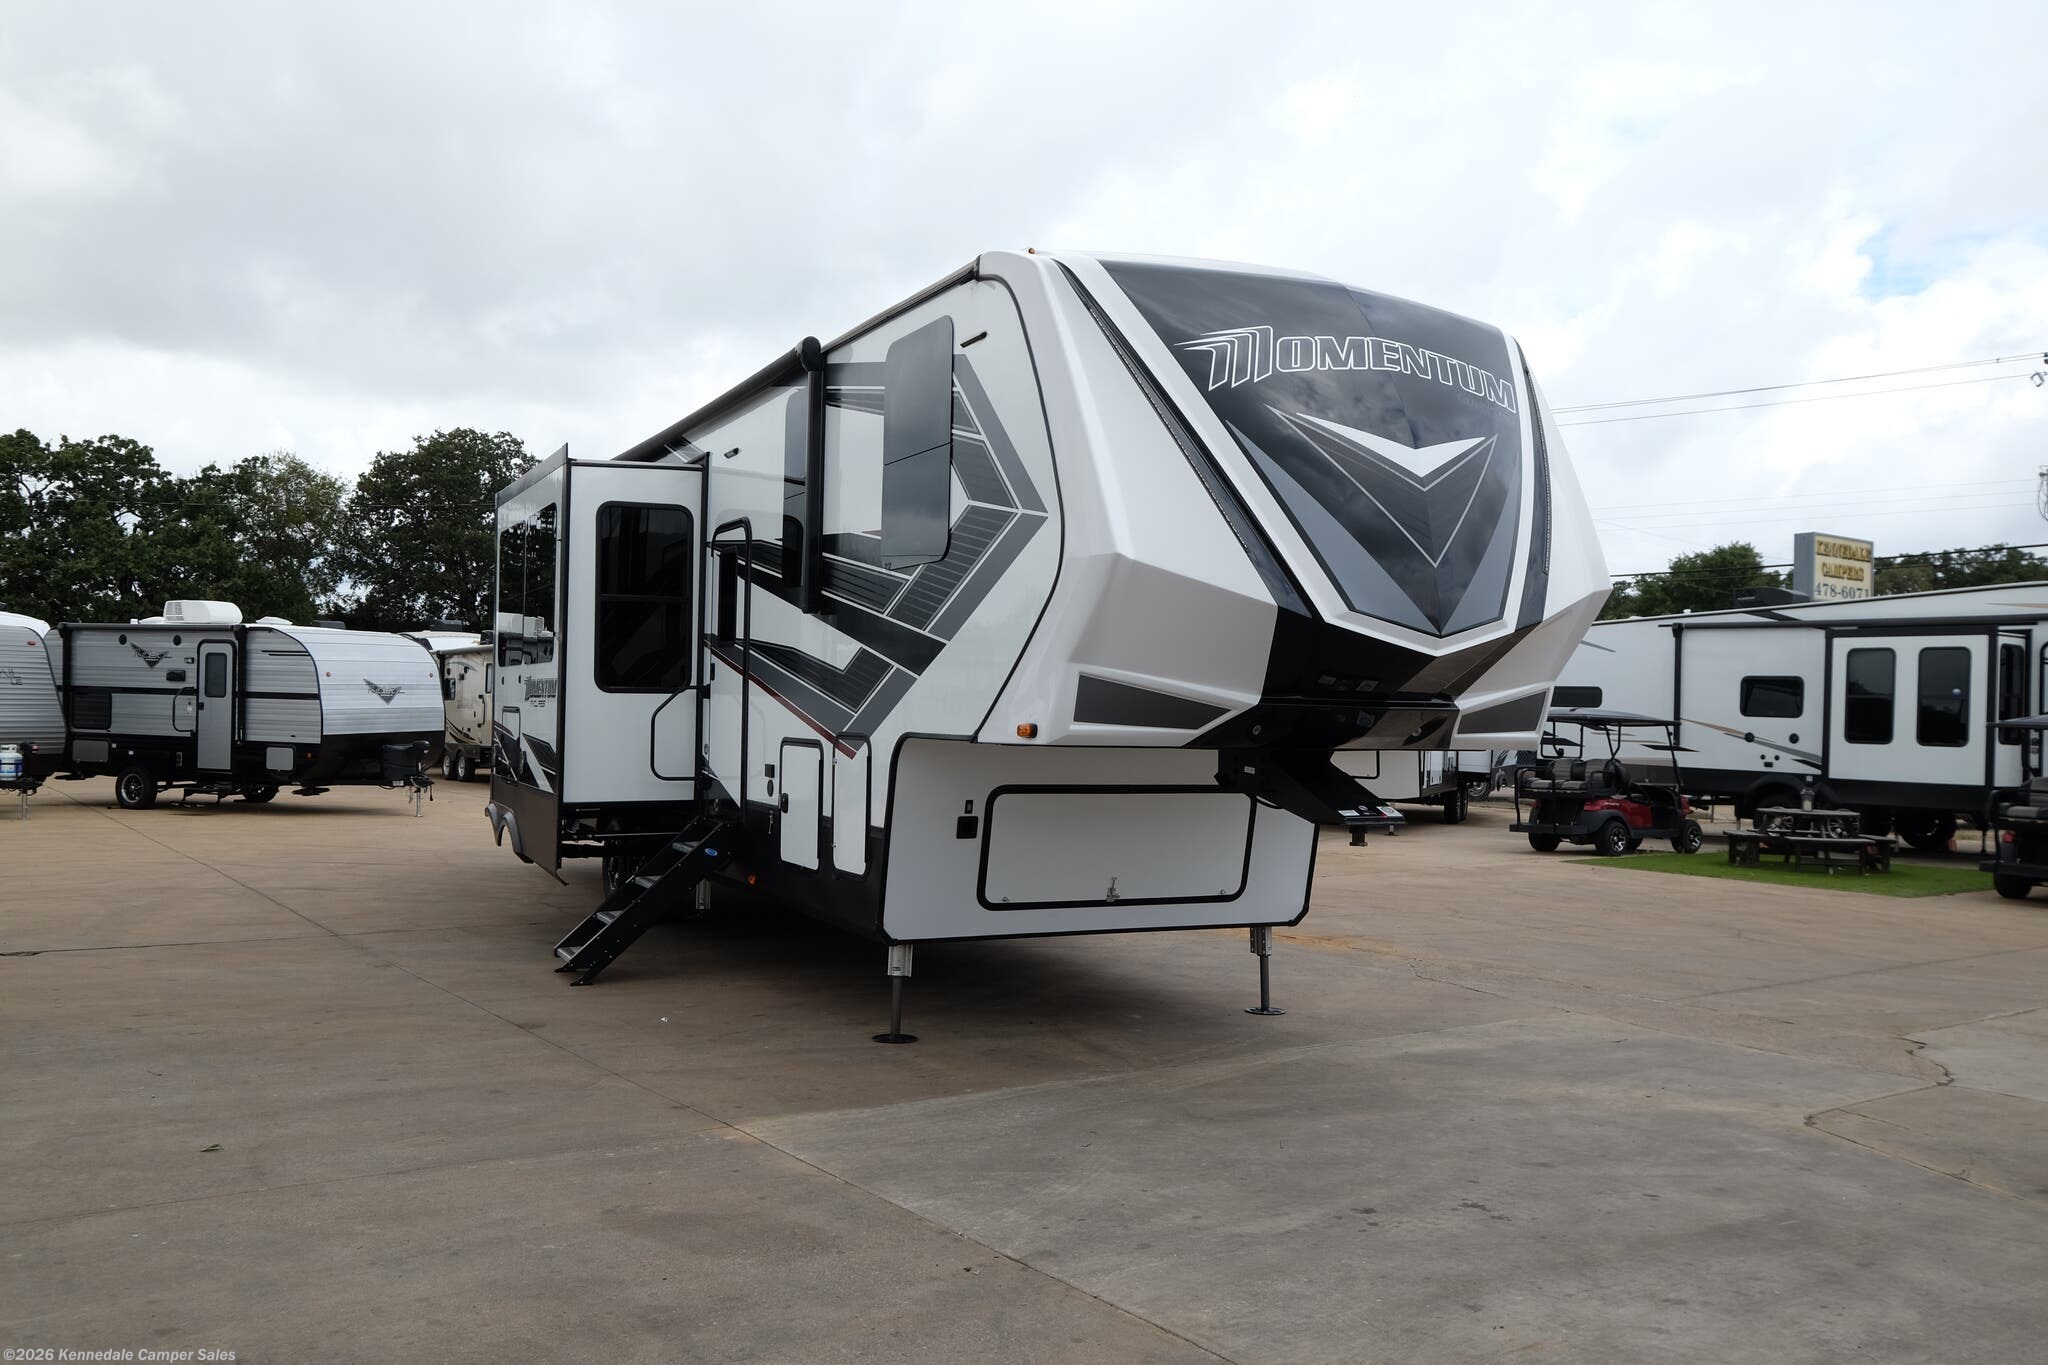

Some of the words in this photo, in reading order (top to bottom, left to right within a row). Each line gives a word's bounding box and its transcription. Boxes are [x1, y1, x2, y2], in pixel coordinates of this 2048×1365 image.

[1173, 325, 1517, 414] MOMENTUM
[1821, 561, 1864, 582] CAMPERS
[1814, 581, 1870, 599] 478-6071
